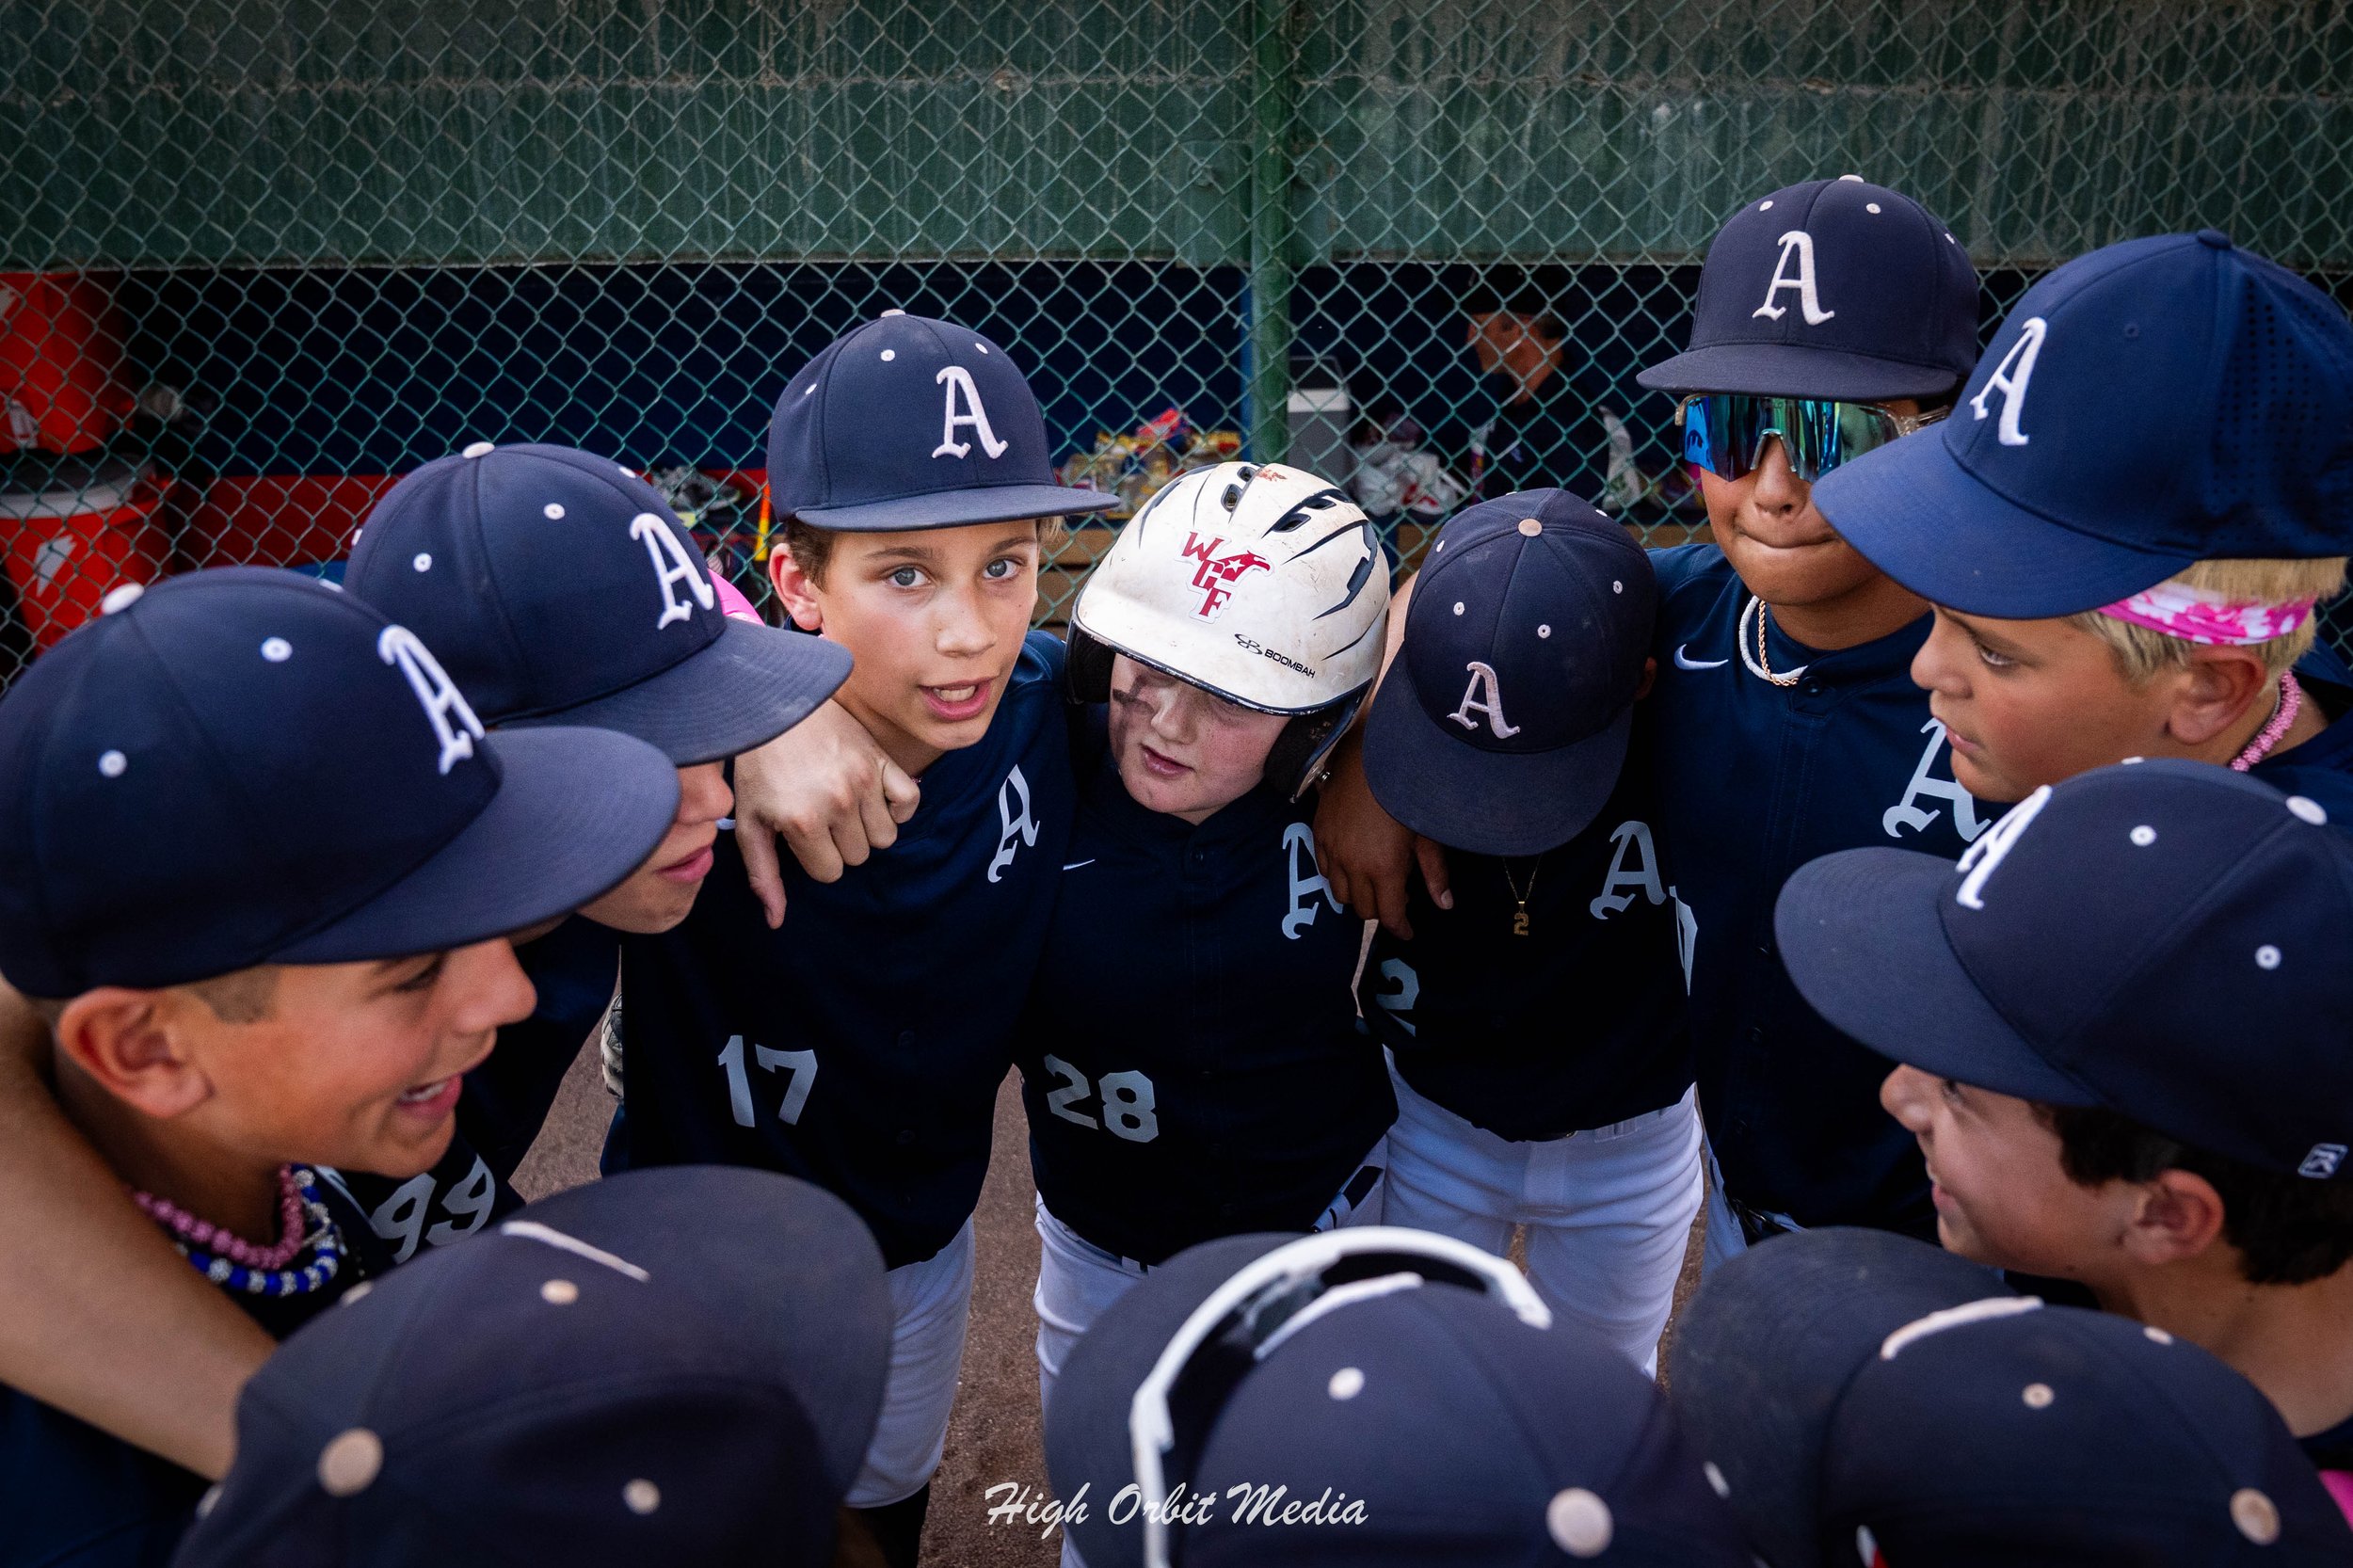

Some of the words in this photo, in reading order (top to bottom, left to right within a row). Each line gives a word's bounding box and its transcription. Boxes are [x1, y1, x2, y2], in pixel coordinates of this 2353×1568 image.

[1753, 230, 1835, 326] A
[931, 365, 1009, 459] A
[1970, 316, 2048, 446] A
[629, 512, 715, 630] A
[378, 624, 486, 775] A
[1264, 648, 1316, 679] BOOMBAH
[1447, 661, 1521, 740] A
[987, 763, 1040, 884] A
[1882, 716, 1992, 842] A
[1281, 822, 1344, 940] A
[1590, 820, 1667, 920] A
[1955, 784, 2053, 910] A
[1513, 912, 1530, 936] 2
[717, 1034, 819, 1128] 17
[1044, 1053, 1160, 1143] 28
[371, 1153, 496, 1265] 99
